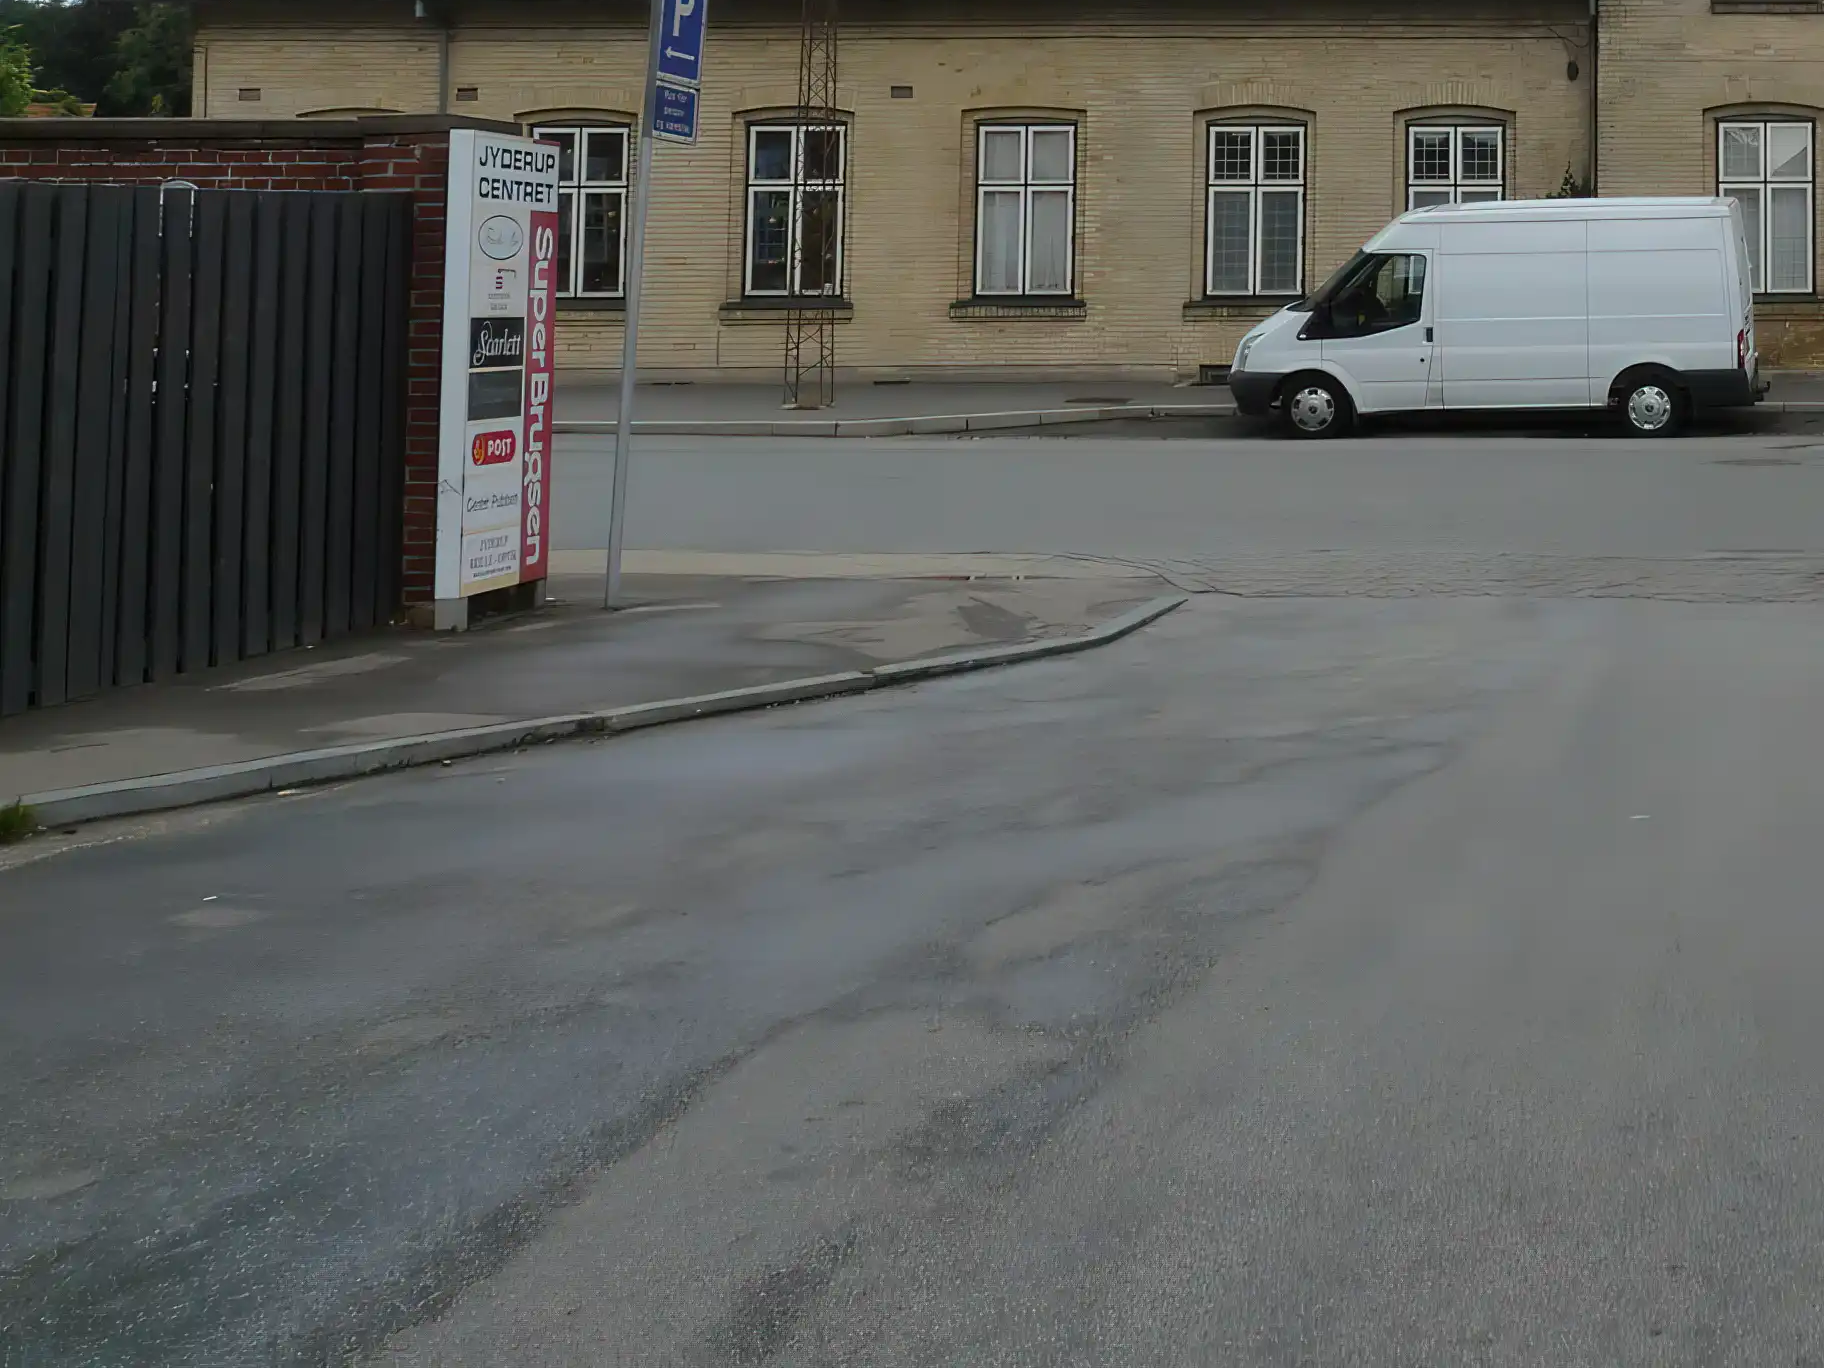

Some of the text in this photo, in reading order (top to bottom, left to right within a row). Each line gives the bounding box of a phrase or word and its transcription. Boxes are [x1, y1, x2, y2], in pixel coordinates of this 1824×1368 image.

[479, 145, 555, 173] JYDERUP
[479, 176, 554, 204] CENTRET
[473, 321, 521, 365] Scarlett
[487, 438, 512, 456] POST
